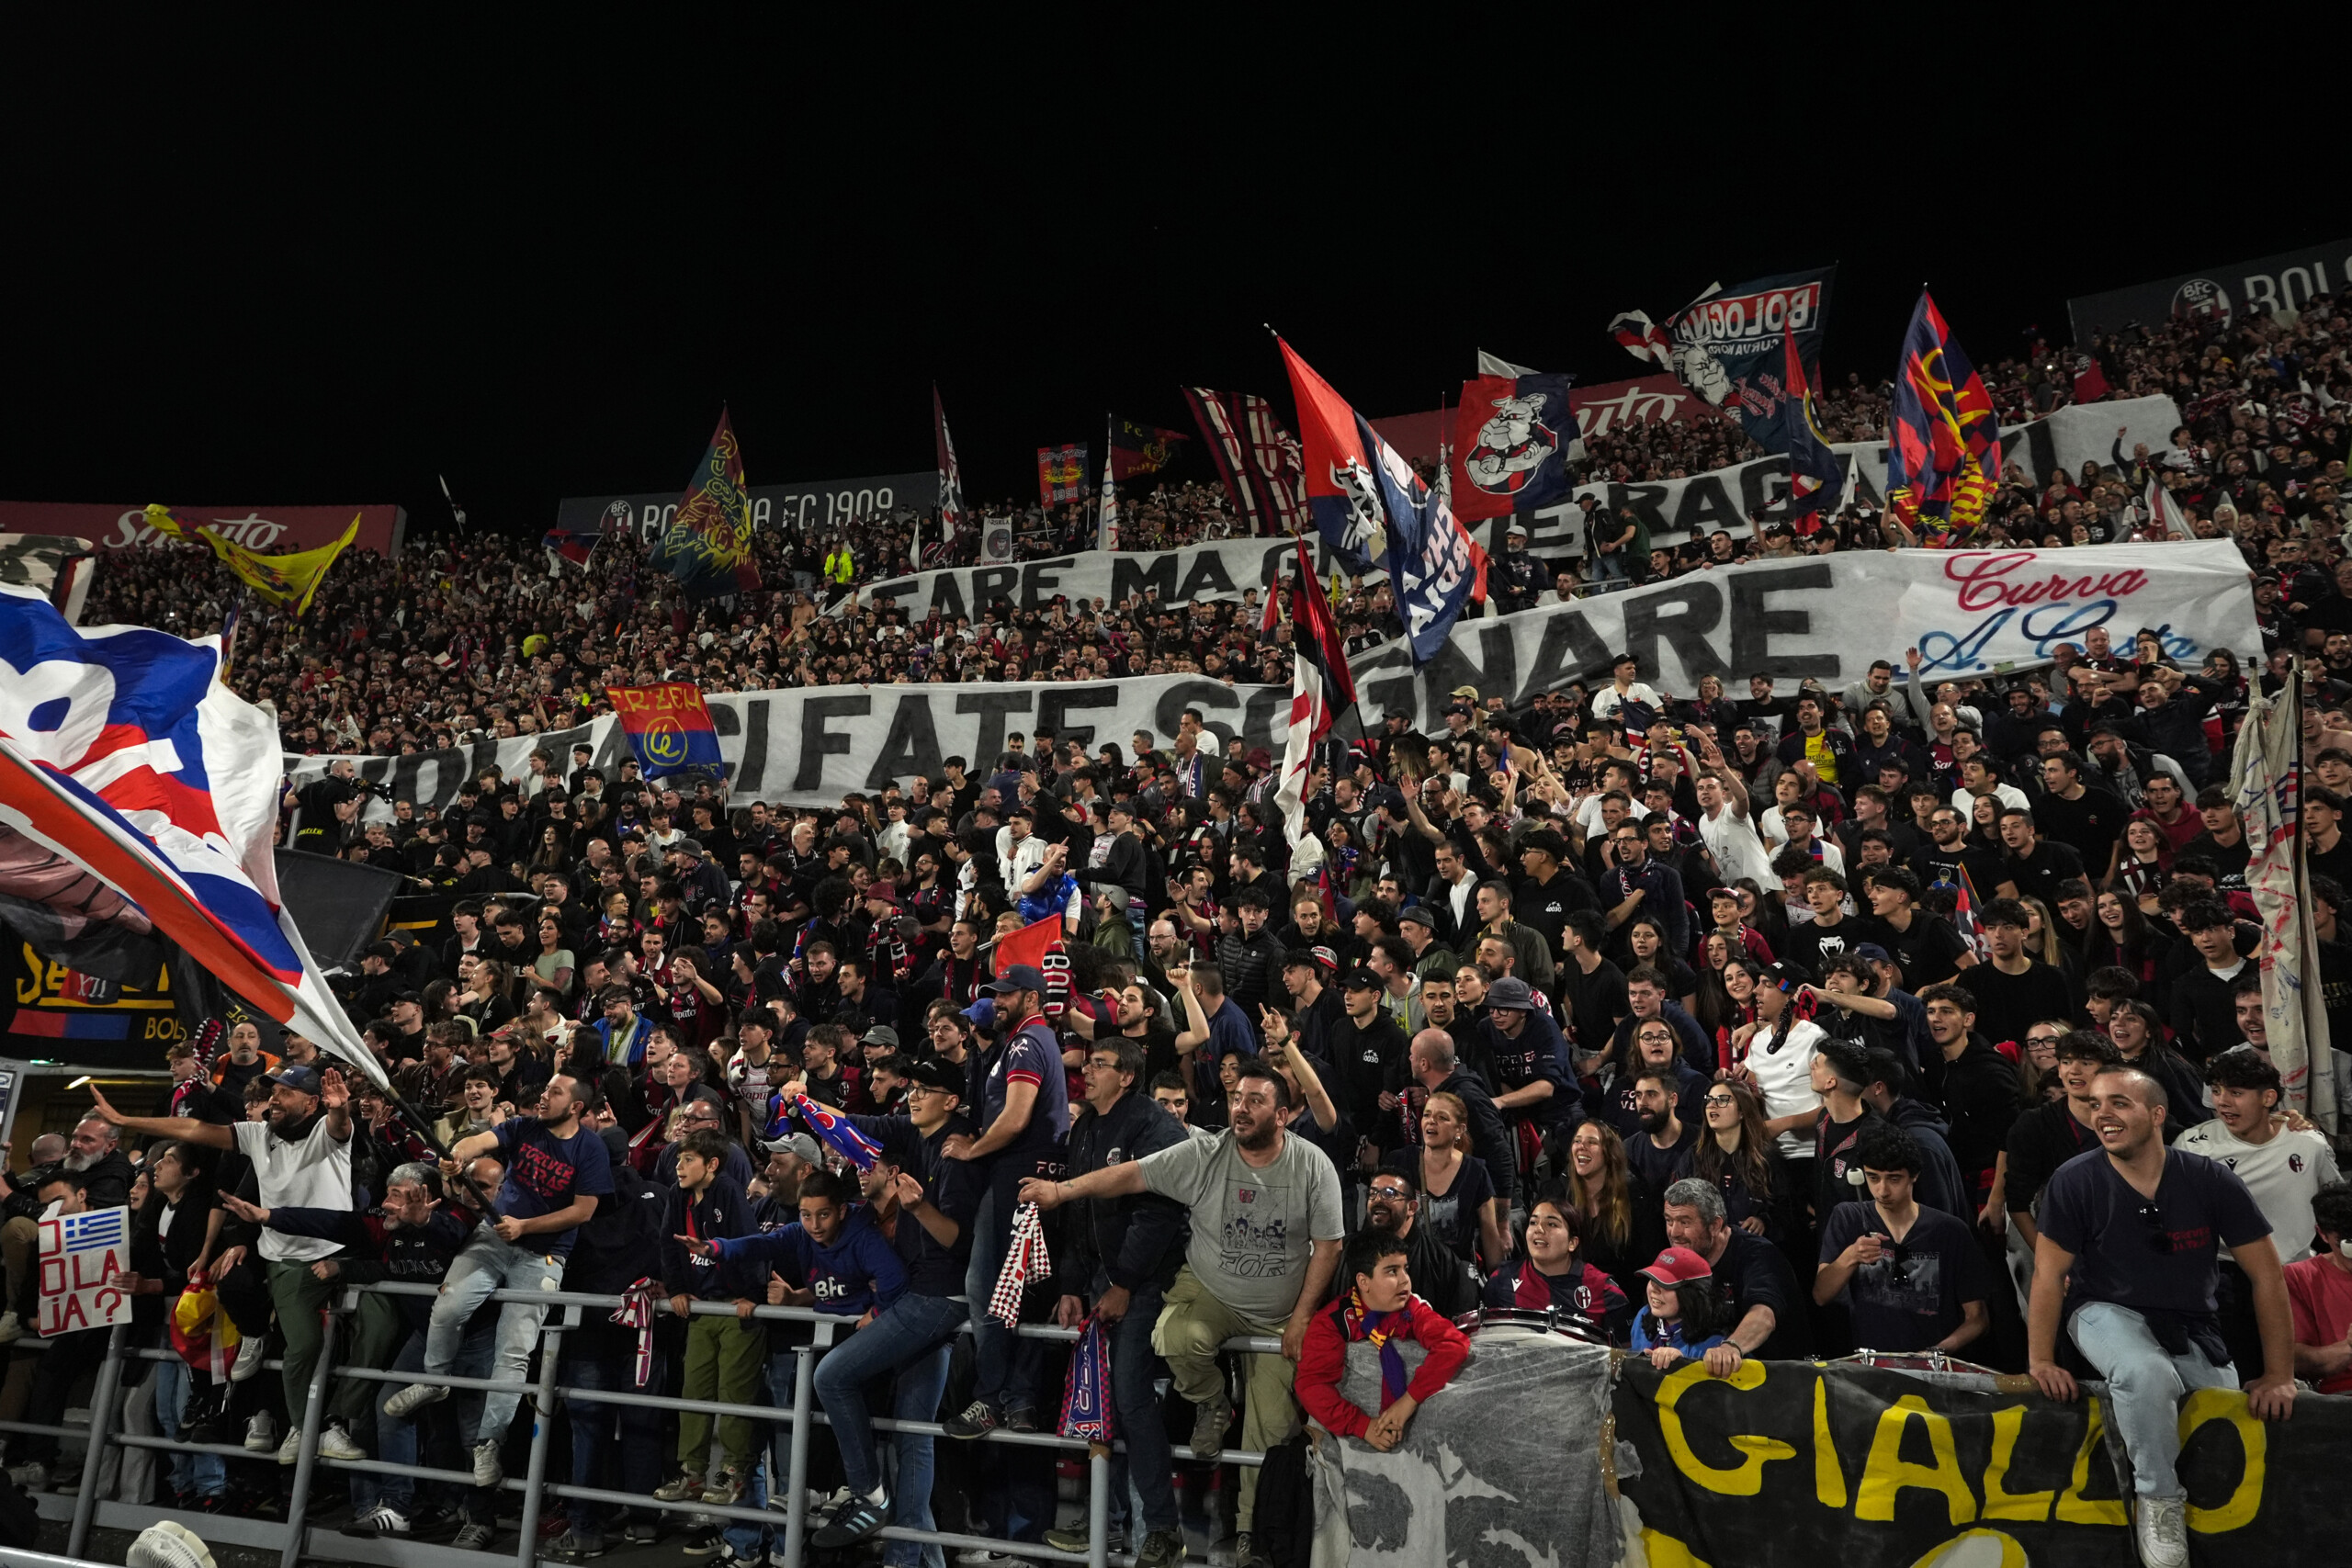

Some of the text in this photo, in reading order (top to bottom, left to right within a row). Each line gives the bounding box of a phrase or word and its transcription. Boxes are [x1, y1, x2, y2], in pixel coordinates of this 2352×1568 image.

[2183, 281, 2212, 299] BFC
[1574, 385, 1687, 439] uto
[610, 502, 627, 513] BFC
[824, 488, 894, 530] 1909
[1053, 489, 1079, 502] 1991
[102, 510, 288, 550] Sauto
[1945, 552, 2148, 612] Curva
[2020, 600, 2198, 661] Csta
[792, 684, 1119, 790] FATE
[741, 1087, 768, 1102] Sapu
[1905, 1250, 1940, 1261] LTRAS
[1654, 1358, 2266, 1534] GIALLO
